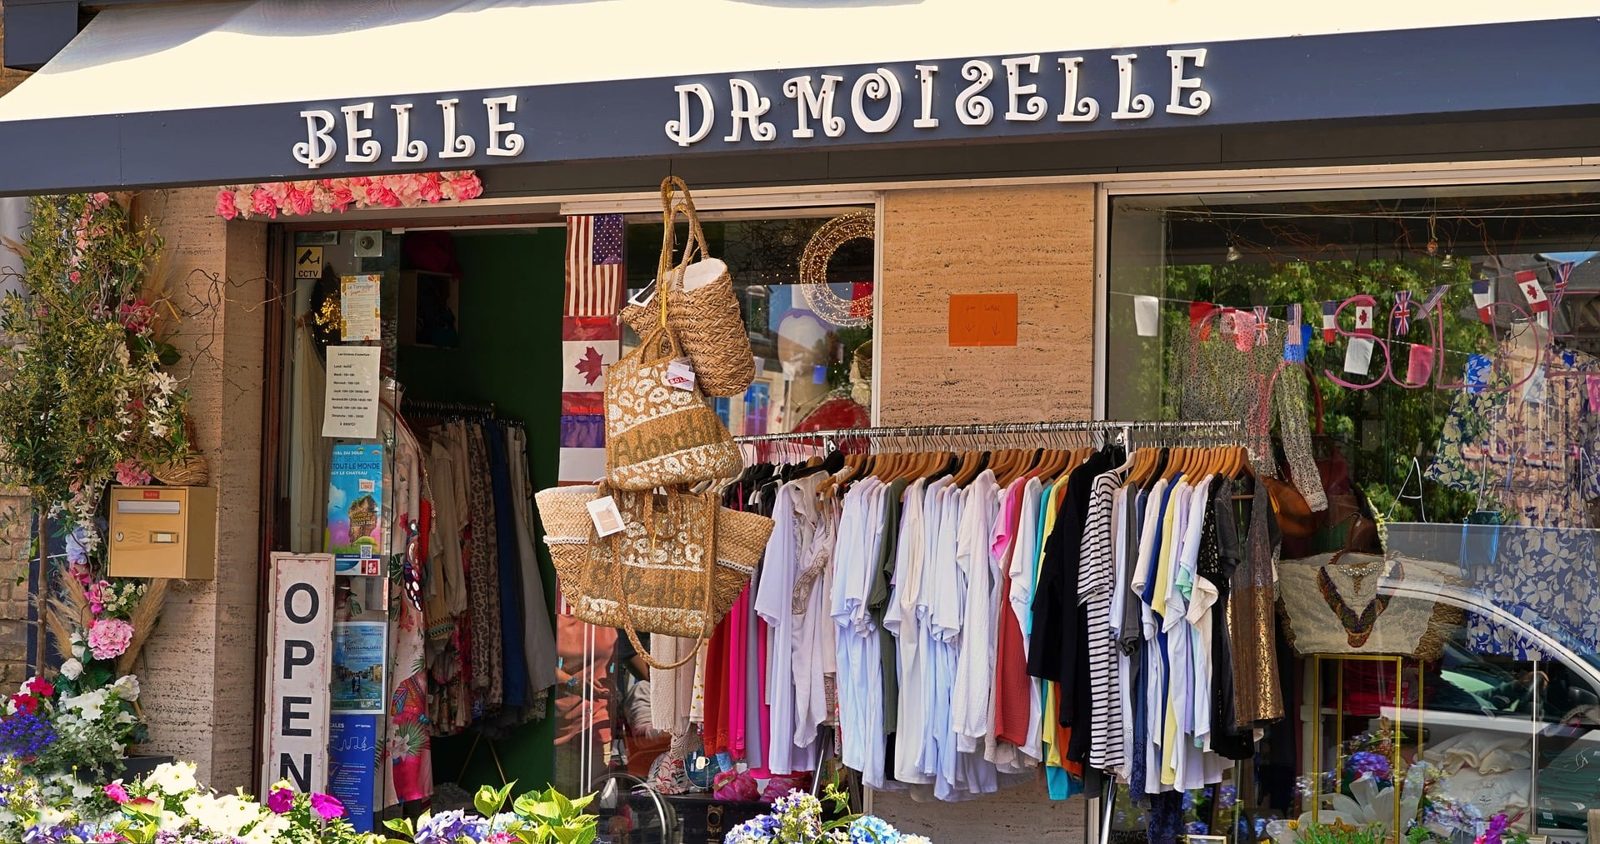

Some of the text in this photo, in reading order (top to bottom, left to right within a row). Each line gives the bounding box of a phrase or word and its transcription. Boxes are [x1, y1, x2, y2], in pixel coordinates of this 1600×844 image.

[292, 48, 1211, 169] BELLE DAMOISELLE
[298, 270, 319, 278] CCTV
[357, 462, 380, 470] MONDE
[280, 582, 320, 793] OPEN
